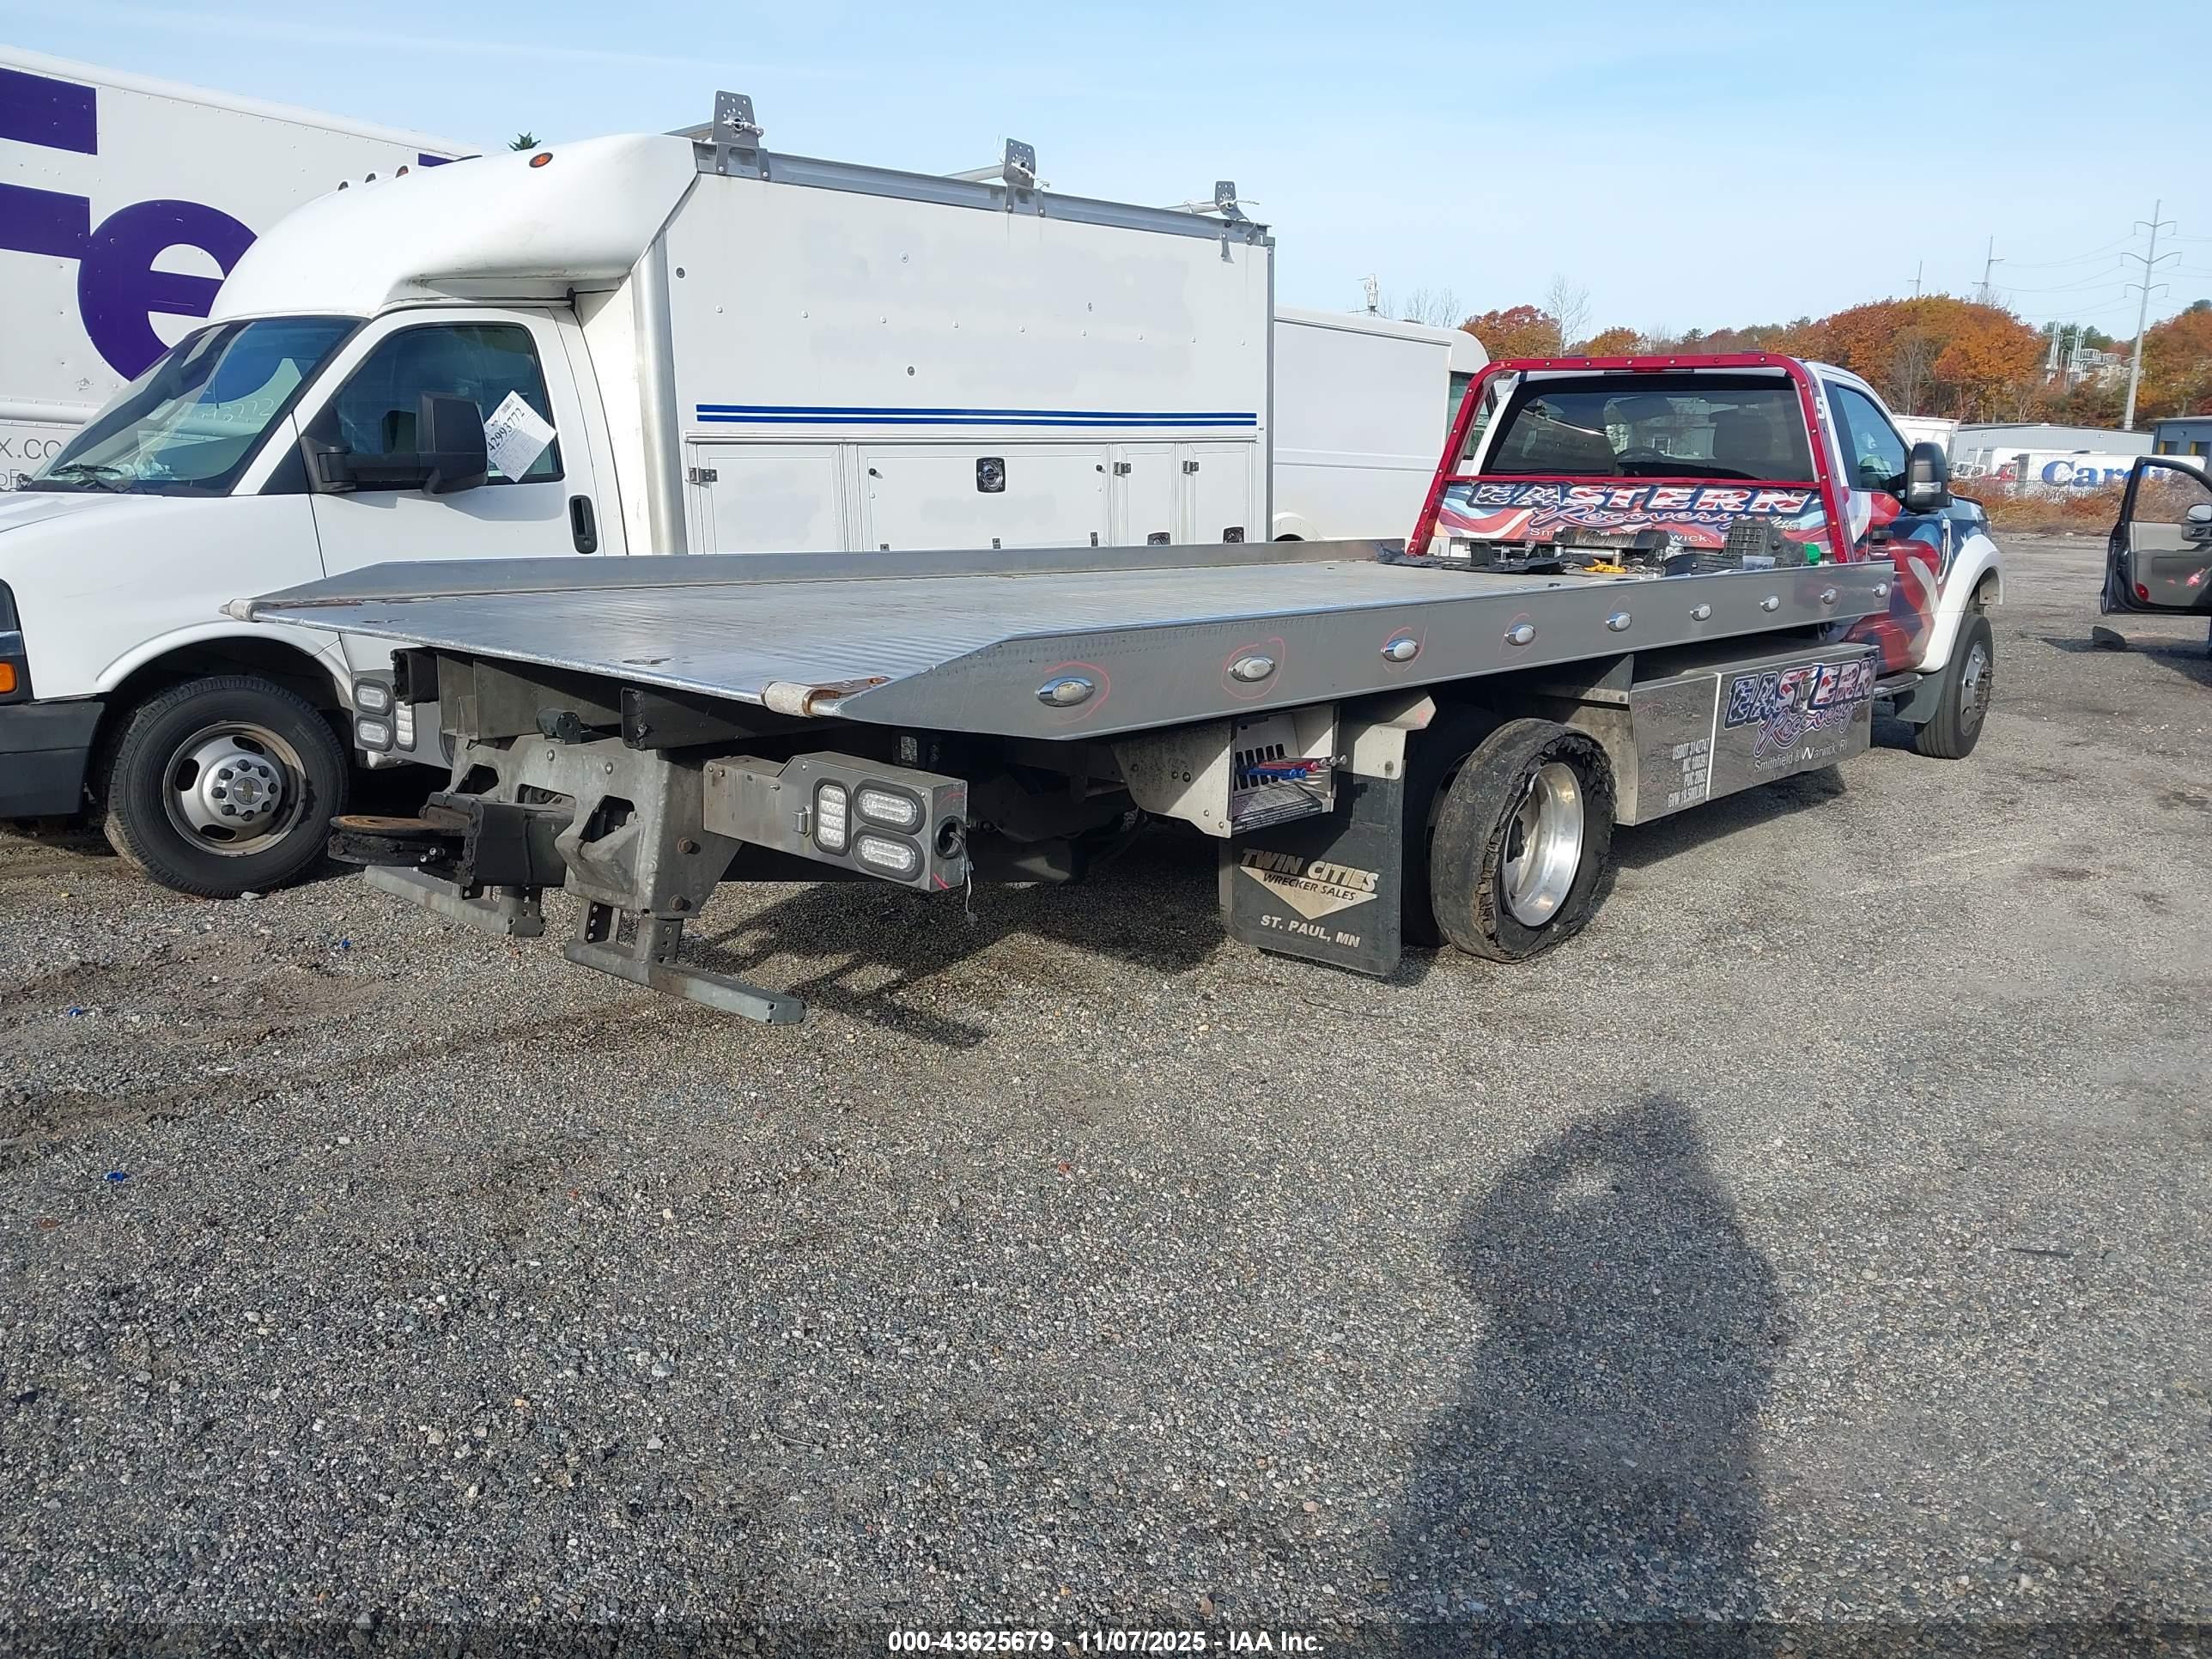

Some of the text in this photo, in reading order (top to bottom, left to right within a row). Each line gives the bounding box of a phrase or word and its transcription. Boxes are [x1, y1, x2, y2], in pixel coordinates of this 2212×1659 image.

[488, 407, 525, 451] 42993772
[1470, 483, 1813, 514] EASTERN
[1528, 504, 1750, 532] Recovery
[1723, 656, 1876, 730] EASTERN
[1753, 706, 1858, 757] Recovery
[1672, 743, 1690, 761] USDOT
[1754, 738, 1847, 773] Smithfield & Warwick, RI
[1668, 790, 1681, 808] GVW
[1241, 848, 1380, 892] TWIN CITIES
[1262, 872, 1356, 902] WRECKER SALES
[1260, 914, 1361, 948] ST. PAUL, MN
